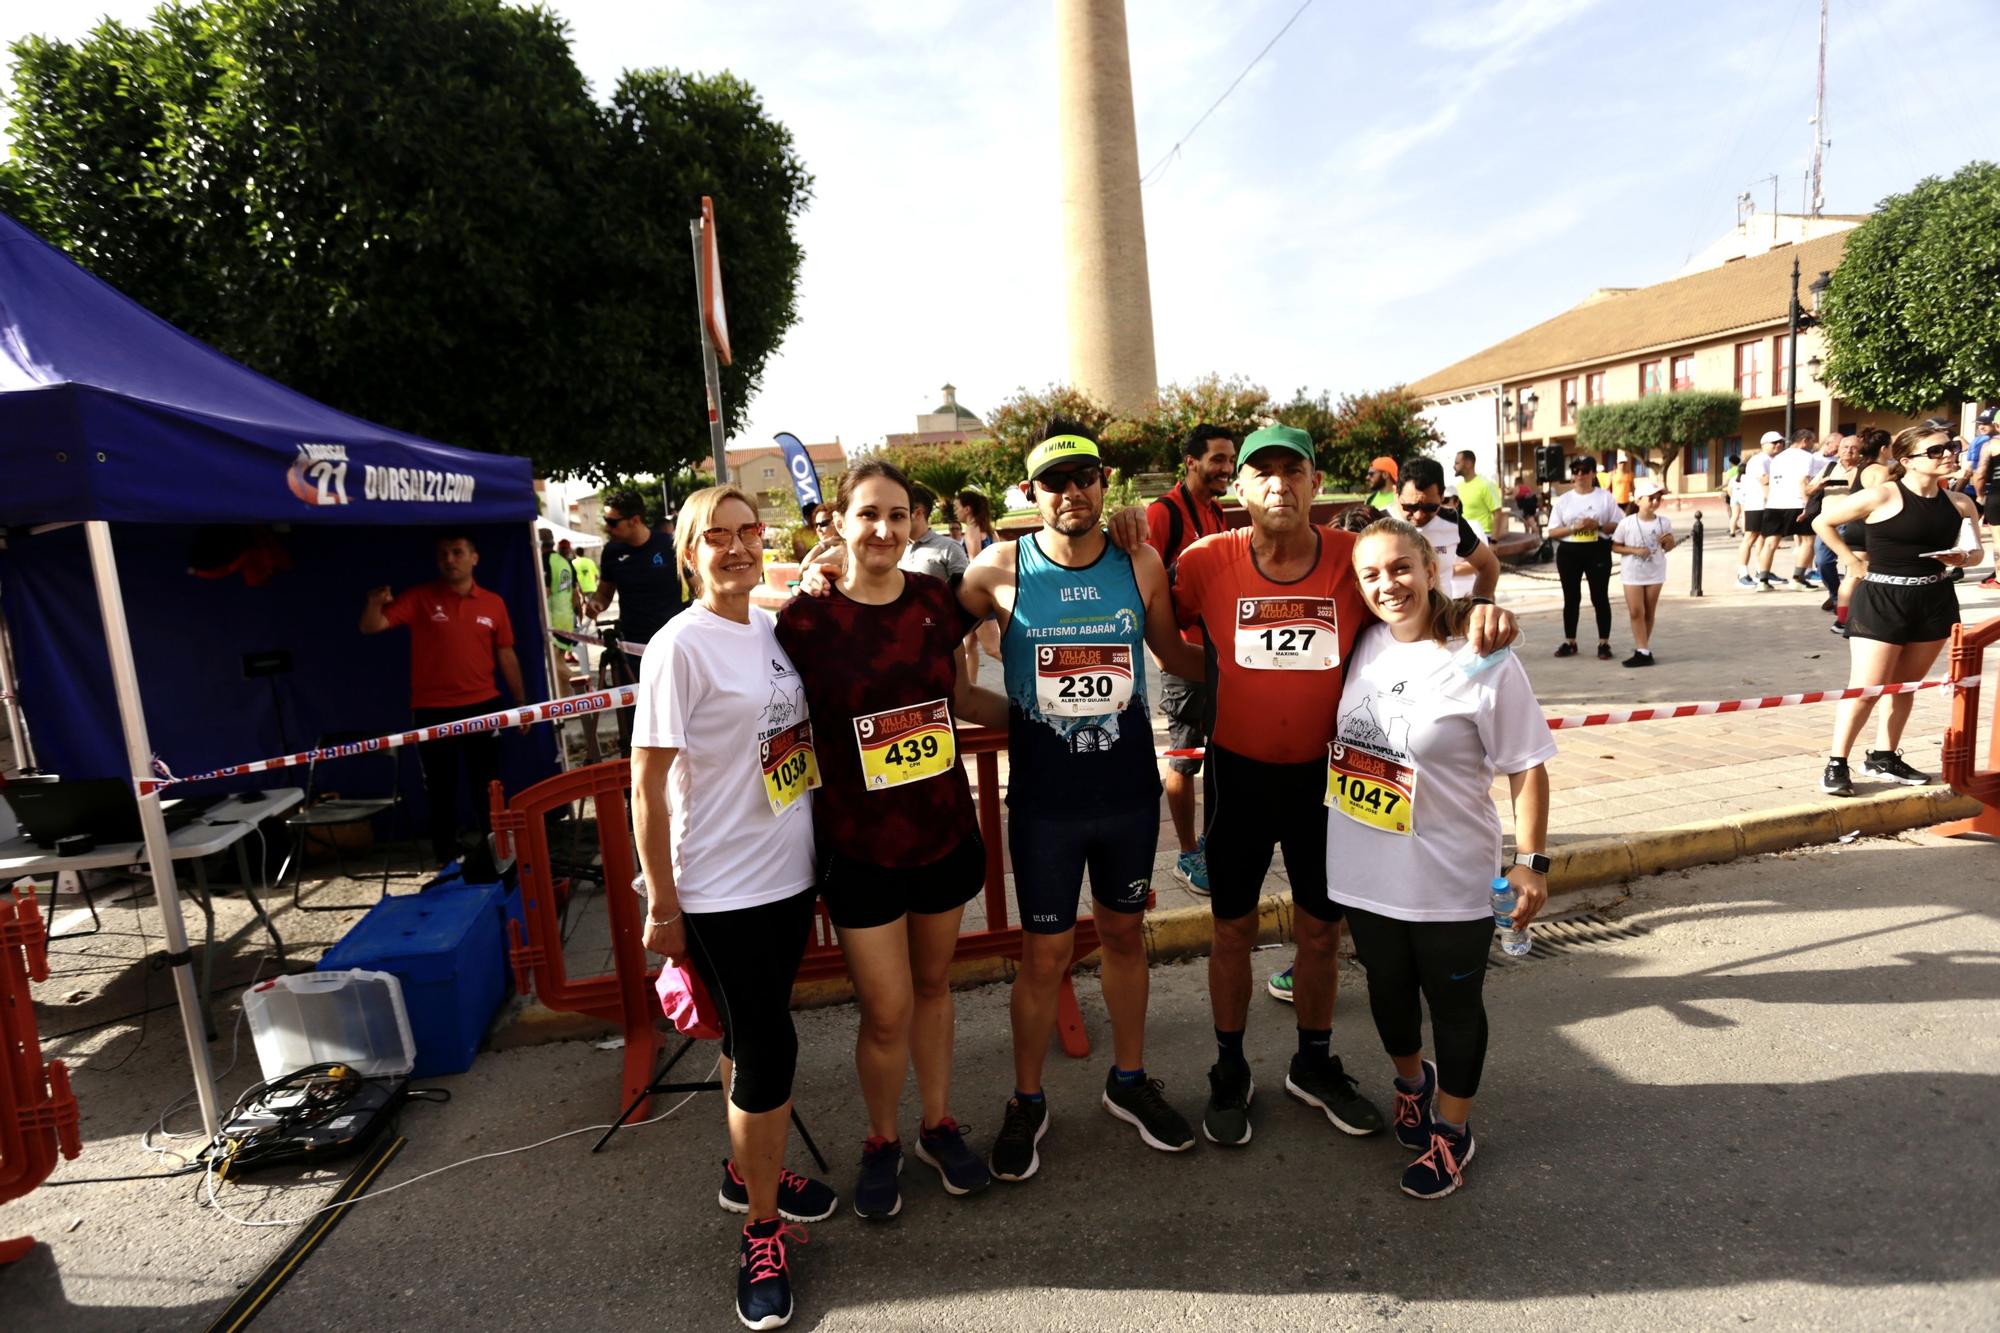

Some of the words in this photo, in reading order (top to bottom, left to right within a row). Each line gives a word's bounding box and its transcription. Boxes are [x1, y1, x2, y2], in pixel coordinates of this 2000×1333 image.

[310, 462, 349, 506] 21
[364, 465, 475, 503] DORSAL21.COM
[1868, 573, 1906, 585] NIKE
[1906, 575, 1938, 586] PRO
[1260, 604, 1288, 612] VILLA
[1291, 603, 1305, 612] DE
[1260, 611, 1305, 619] ALGUAZAS
[1026, 626, 1077, 638] ATLETISMO
[1079, 622, 1116, 634] ABARÁN
[1260, 629, 1317, 651] 127
[1059, 650, 1087, 659] VILLA
[1088, 650, 1101, 658] DE
[1058, 675, 1113, 698] 230
[550, 697, 605, 716] FAMU
[438, 716, 500, 737] FAMU
[879, 714, 908, 728] VILLA
[909, 710, 922, 721] DE
[884, 735, 939, 766] 439
[1372, 744, 1407, 759] POPULAR
[772, 752, 807, 791] 1038
[1337, 774, 1401, 815] 1047
